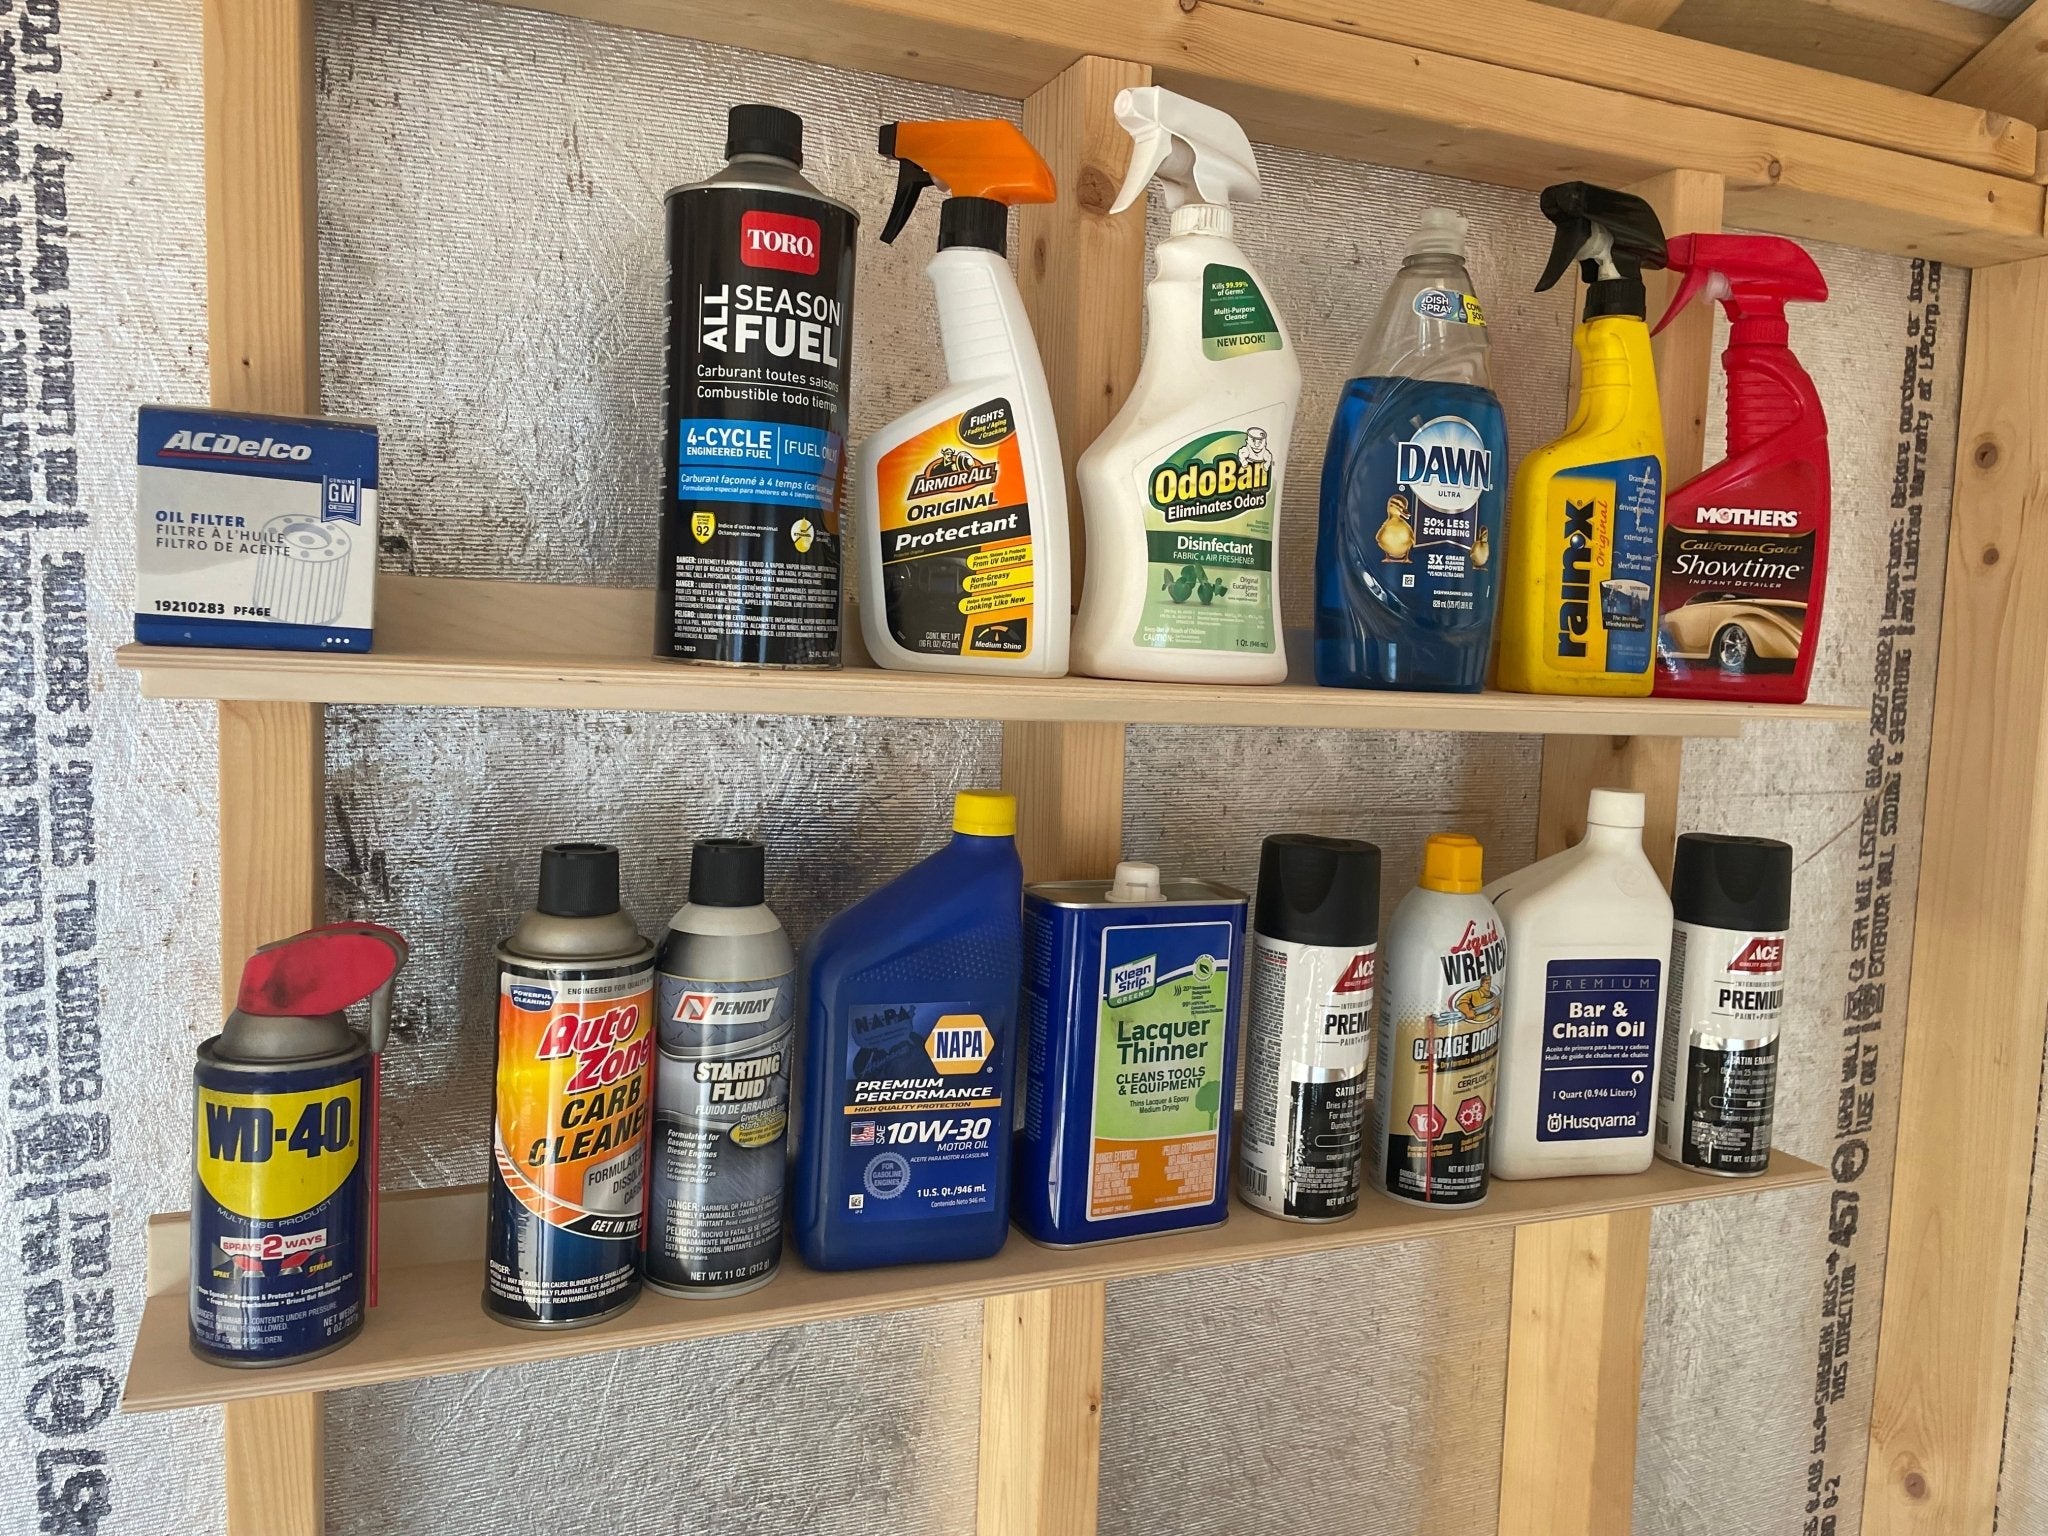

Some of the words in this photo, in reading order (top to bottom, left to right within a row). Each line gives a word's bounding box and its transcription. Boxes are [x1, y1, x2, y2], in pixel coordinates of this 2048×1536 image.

[748, 229, 813, 257] TORO
[735, 285, 840, 326] SEASON
[1421, 304, 1452, 313] SPRAY
[1425, 296, 1448, 305] DISH
[703, 284, 728, 352] ALL
[1214, 306, 1255, 315] Multi-Purpose
[735, 314, 838, 368] FUEL
[1217, 338, 1237, 347] NEW
[1239, 335, 1265, 344] LOOK!
[697, 365, 761, 379] Carburant
[766, 368, 806, 384] toutes
[810, 377, 839, 392] saisons
[697, 386, 778, 402] Combustible
[782, 391, 809, 406] todo
[812, 396, 838, 413] tiempo
[971, 409, 1004, 427] FIGHTS
[164, 430, 312, 461] ACDelco
[687, 428, 772, 449] 4-CYCLE
[687, 448, 743, 457] ENGINEERED
[746, 449, 771, 459] FUEL
[1397, 442, 1491, 491] DAWN
[681, 474, 719, 484] Carburant
[721, 475, 756, 486] façonné
[760, 477, 764, 486] à
[767, 478, 773, 486] 4
[775, 479, 802, 490] temps
[1155, 460, 1268, 503] OdoBan
[328, 484, 354, 503] GM
[907, 492, 998, 521] ORIGINAL
[1168, 500, 1232, 519] Eliminates
[1234, 495, 1264, 509] Odors
[155, 511, 184, 524] OIL
[192, 513, 245, 527] FILTER
[1424, 518, 1444, 527] 50%
[1447, 519, 1470, 529] LESS
[1697, 508, 1797, 527] MOTHERS
[156, 525, 204, 538] FILTRE
[212, 525, 221, 538] À
[228, 530, 284, 543] L'HUILE
[696, 526, 710, 536] 92
[895, 514, 1018, 551] Protectant
[1423, 528, 1470, 538] SCRUBBING
[1596, 500, 1607, 567] Original
[156, 538, 208, 550] FILTRO
[215, 541, 233, 552] DE
[239, 543, 290, 556] ACEITE
[1178, 536, 1253, 555] Disinfectant
[1680, 540, 1757, 553] California
[1759, 543, 1798, 554] Gold
[973, 560, 988, 568] From
[1000, 554, 1026, 564] Damage
[1173, 552, 1198, 560] FABRIC
[1219, 555, 1254, 564] FRESHENER
[1428, 554, 1443, 565] 3X
[1672, 554, 1800, 579] Showtime
[970, 572, 1010, 583] Non-Greasy
[970, 580, 997, 590] Formula
[1233, 583, 1258, 591] Eucalyptus
[155, 601, 225, 614] 19210283
[234, 606, 271, 616] PF46E
[966, 601, 992, 611] Looking
[995, 600, 1009, 608] Like
[1011, 596, 1025, 604] New
[1451, 920, 1498, 956] Liquid
[1749, 946, 1779, 960] ACE
[1115, 964, 1151, 983] Klean
[1353, 960, 1374, 978] ACE
[568, 986, 612, 995] ENGINEERED
[1118, 977, 1147, 993] Strip
[1552, 979, 1649, 990] PREMIUM
[513, 990, 552, 1000] POWERFUL
[514, 997, 551, 1006] CLEANING
[1116, 992, 1144, 1004] GREEN
[712, 998, 771, 1015] PENRAY
[1569, 1002, 1605, 1018] Bar
[1612, 1002, 1628, 1017] &
[536, 1005, 639, 1059] Auto
[1117, 1019, 1210, 1044] Lacquer
[1553, 1022, 1608, 1038] Chain
[1616, 1021, 1645, 1037] Oil
[936, 1031, 983, 1058] NAPA
[1414, 1035, 1470, 1060] GARAGE
[1117, 1041, 1208, 1065] Thinner
[564, 1030, 650, 1094] Zone
[697, 1054, 780, 1081] STARTING
[1116, 1071, 1164, 1085] CLEANS
[1168, 1067, 1206, 1080] TOOLS
[711, 1079, 765, 1101] FLUID
[855, 1078, 943, 1091] PREMIUM
[1118, 1085, 1127, 1095] &
[1130, 1078, 1202, 1094] EQUIPMENT
[1335, 1086, 1354, 1097] SATIN
[561, 1075, 641, 1129] CARB
[855, 1087, 993, 1102] PERFORMANCE
[1559, 1091, 1582, 1100] Quart
[1584, 1089, 1608, 1100] (0.946
[1610, 1088, 1636, 1098] Liters)
[695, 1105, 726, 1115] FLUIDO
[728, 1105, 739, 1115] DE
[878, 1104, 915, 1112] QUALITY
[1139, 1105, 1161, 1113] Medium
[1162, 1104, 1179, 1112] Drying
[206, 1097, 351, 1163] WD-40
[1563, 1115, 1636, 1130] Husqvarna
[667, 1129, 707, 1141] Formulated
[709, 1131, 720, 1140] for
[876, 1125, 885, 1144] SAE
[888, 1118, 992, 1144] 10W-30
[667, 1148, 687, 1157] Diesel
[689, 1149, 717, 1158] Engines
[937, 1142, 972, 1152] MOTOR
[974, 1141, 988, 1149] OIL
[873, 1170, 902, 1178] GASOLINE
[923, 1188, 939, 1197] U.S.
[941, 1186, 972, 1196] Qt./946
[974, 1184, 986, 1192] mL
[217, 1207, 274, 1229] MULTI-USE
[279, 1200, 332, 1227] PRODUCT
[1829, 1189, 1860, 1248] 457
[591, 1220, 613, 1232] GET
[615, 1221, 625, 1232] IN
[626, 1221, 638, 1232] THE
[223, 1241, 261, 1251] SPRAYS
[263, 1236, 282, 1258] 2
[285, 1235, 322, 1248] WAYS
[691, 1272, 706, 1280] NET
[709, 1271, 722, 1280] WT.
[724, 1270, 734, 1278] 11
[736, 1267, 746, 1277] OZ
[323, 1316, 337, 1327] NET
